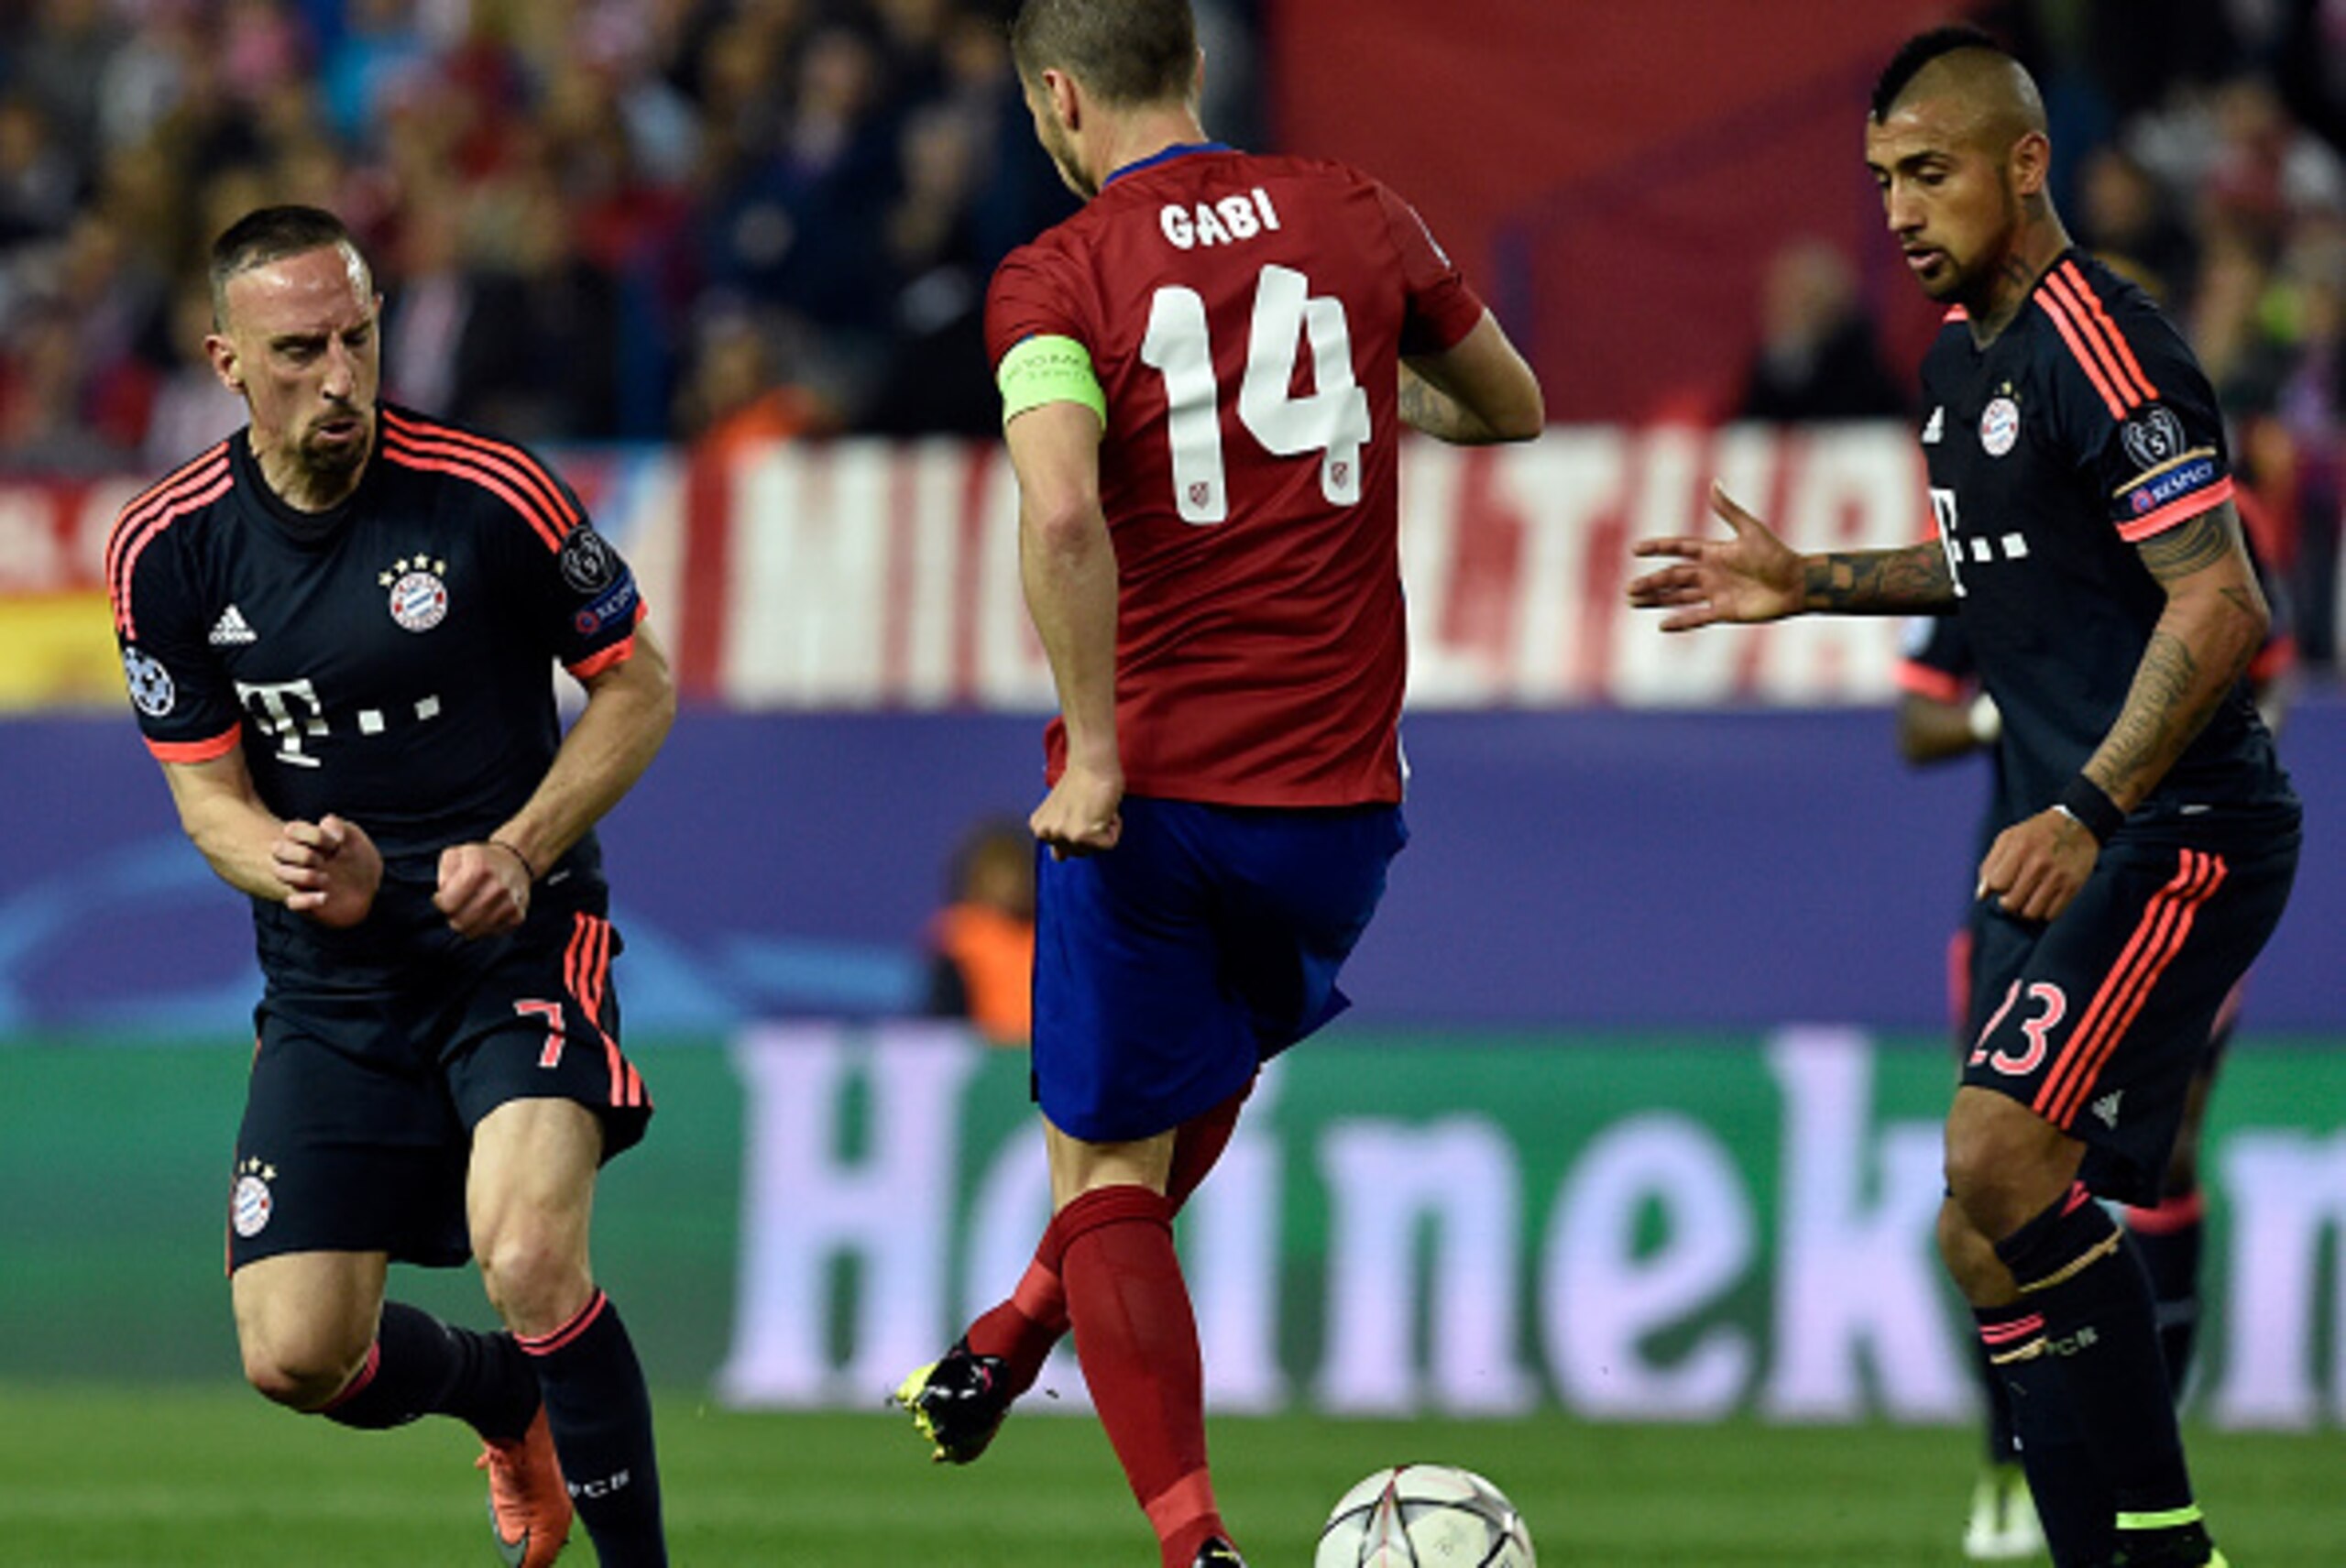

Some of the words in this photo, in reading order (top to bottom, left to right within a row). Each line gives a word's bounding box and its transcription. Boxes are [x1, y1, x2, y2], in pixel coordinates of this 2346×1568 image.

[1160, 187, 1280, 249] GABI
[1141, 263, 1371, 525] 14
[513, 999, 565, 1069] 7
